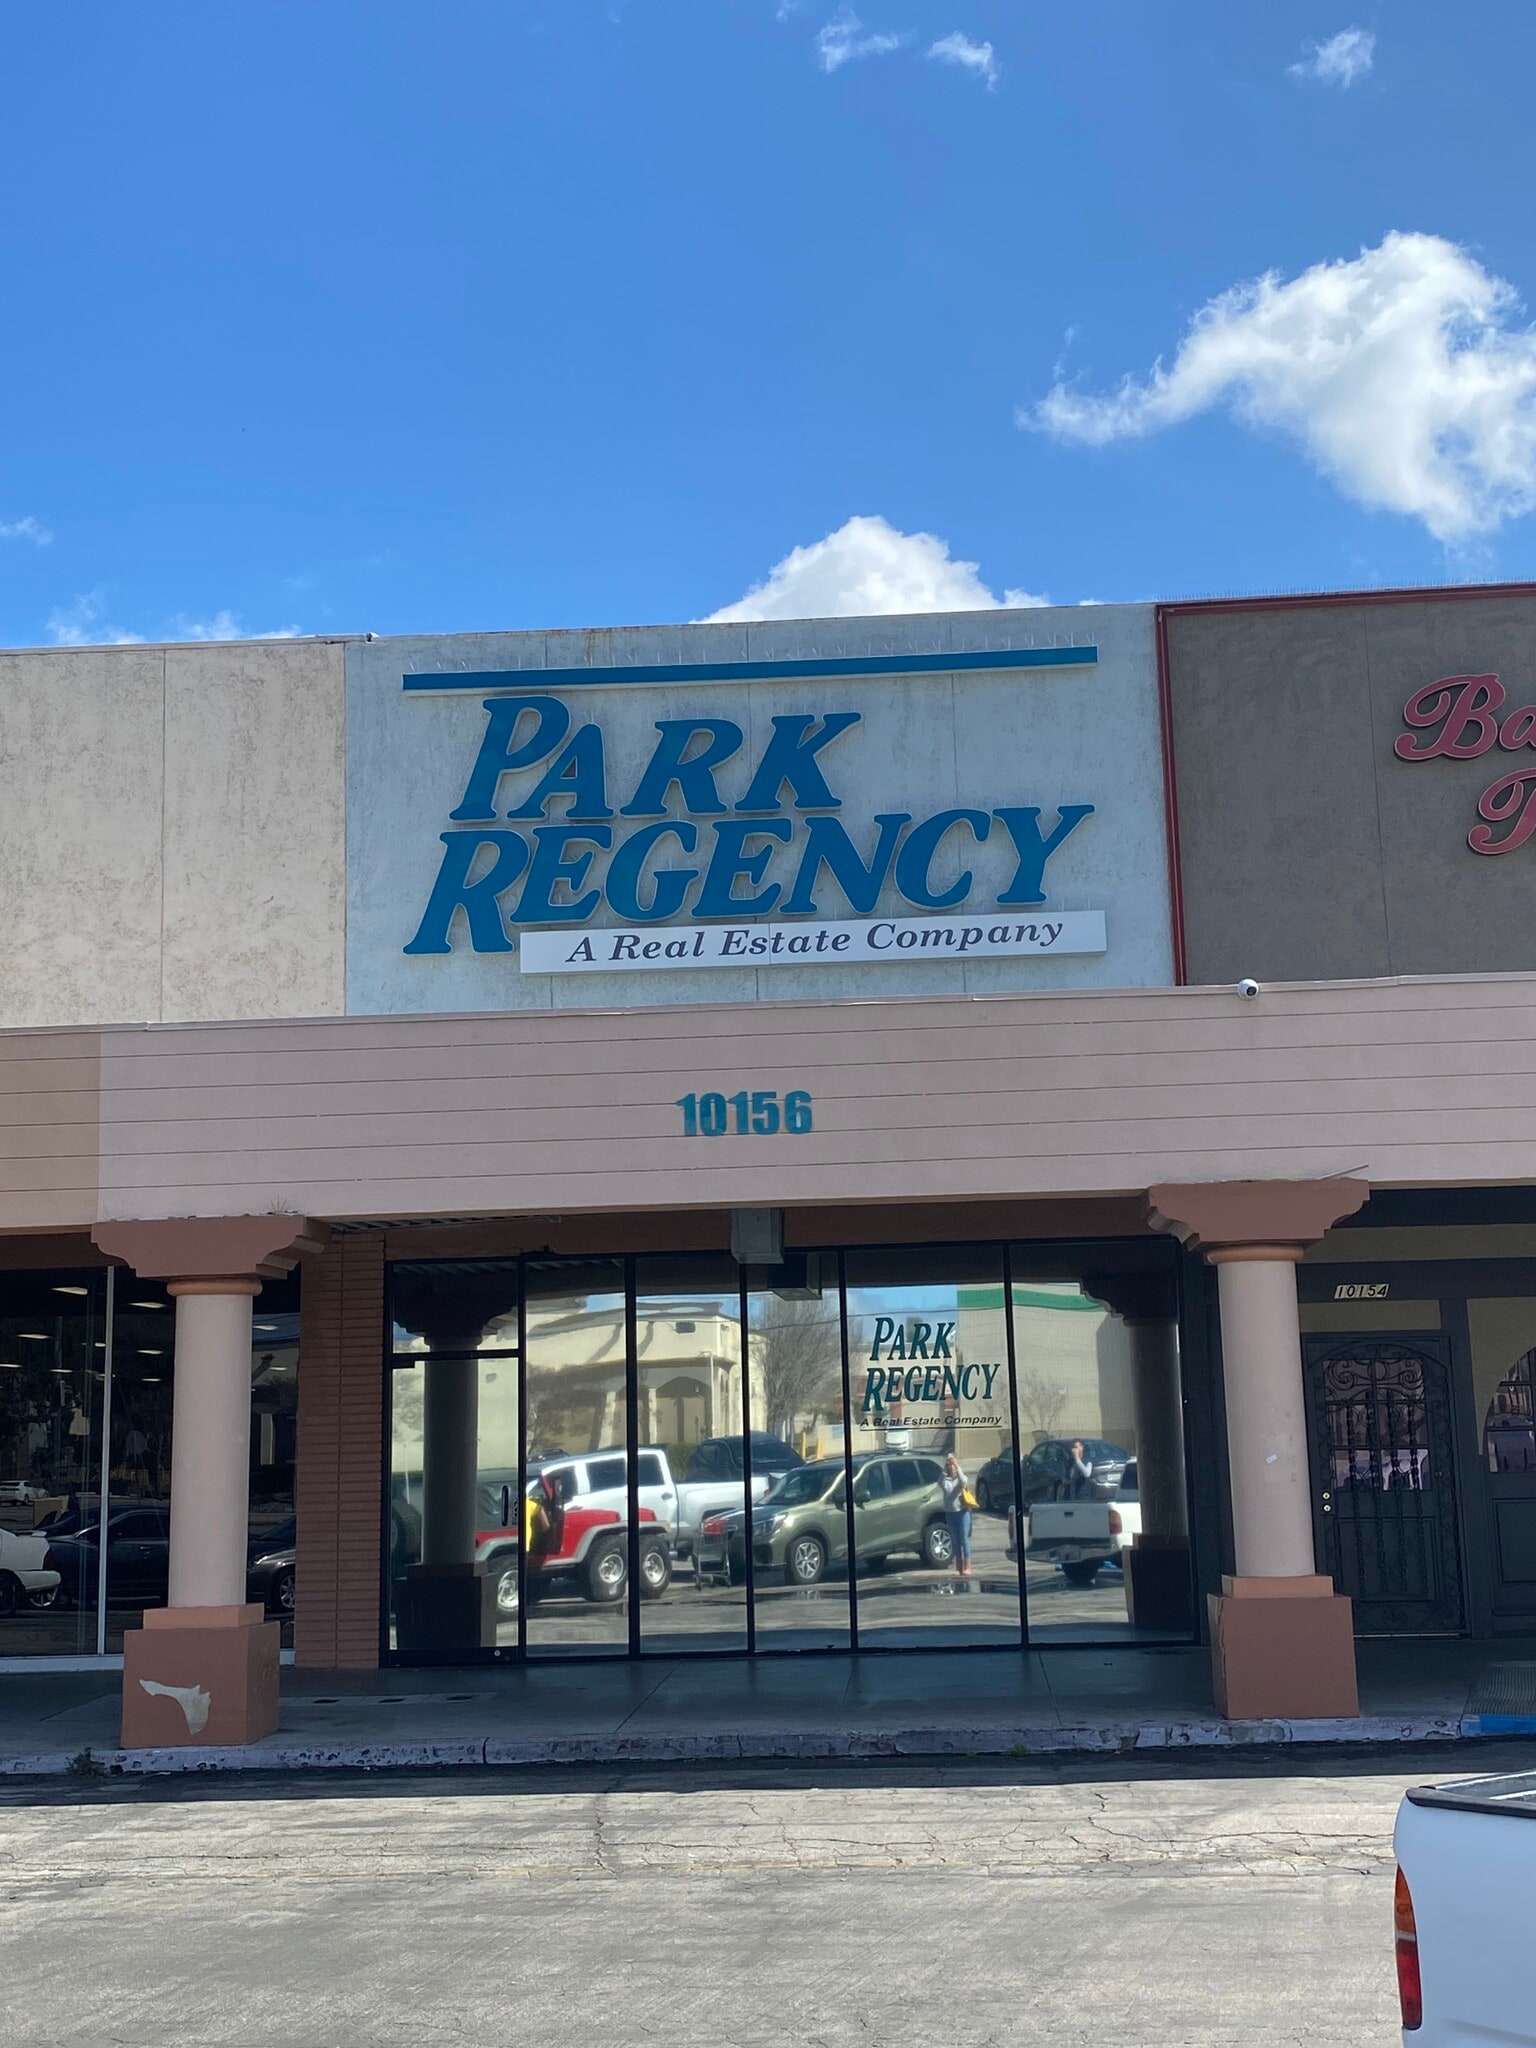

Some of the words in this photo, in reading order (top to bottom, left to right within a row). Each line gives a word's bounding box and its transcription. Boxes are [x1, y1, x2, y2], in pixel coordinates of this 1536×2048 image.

[449, 694, 862, 822] PARK
[403, 804, 1096, 956] REGENCY
[565, 935, 599, 964] A
[609, 932, 706, 963] Real
[719, 929, 853, 957] Estate
[867, 921, 1064, 953] Company
[676, 1090, 813, 1137] 10156
[1337, 1285, 1387, 1297] 10154
[869, 1317, 955, 1361] PARK
[861, 1363, 1000, 1412] REGENCY
[860, 1418, 870, 1427] A
[873, 1418, 901, 1427] Real
[903, 1416, 941, 1425] Estate
[944, 1415, 1002, 1425] Company
